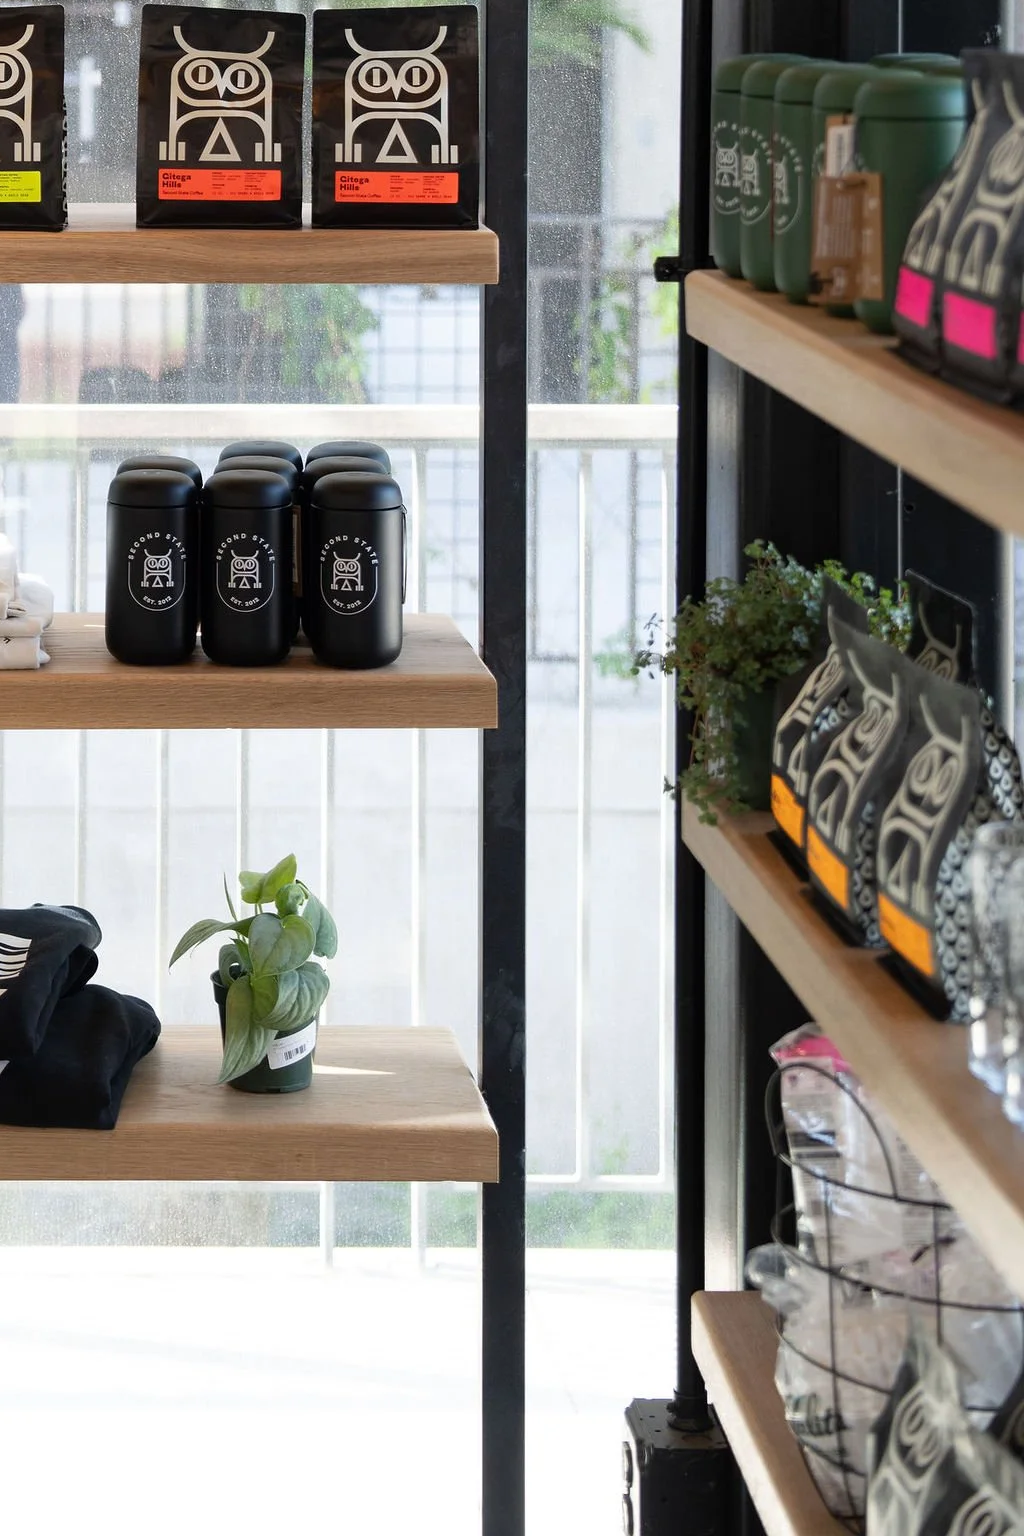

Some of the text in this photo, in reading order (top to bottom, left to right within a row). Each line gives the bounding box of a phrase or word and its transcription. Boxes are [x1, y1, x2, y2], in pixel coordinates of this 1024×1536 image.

[339, 183, 360, 191] Hills
[128, 532, 187, 560] SECOND STATE
[216, 533, 275, 561] SECOND STATE
[320, 535, 378, 564] SECOND STATE
[143, 595, 172, 605] EST. 2012
[230, 596, 260, 606] EST. 2012
[333, 598, 361, 609] EST. 2012
